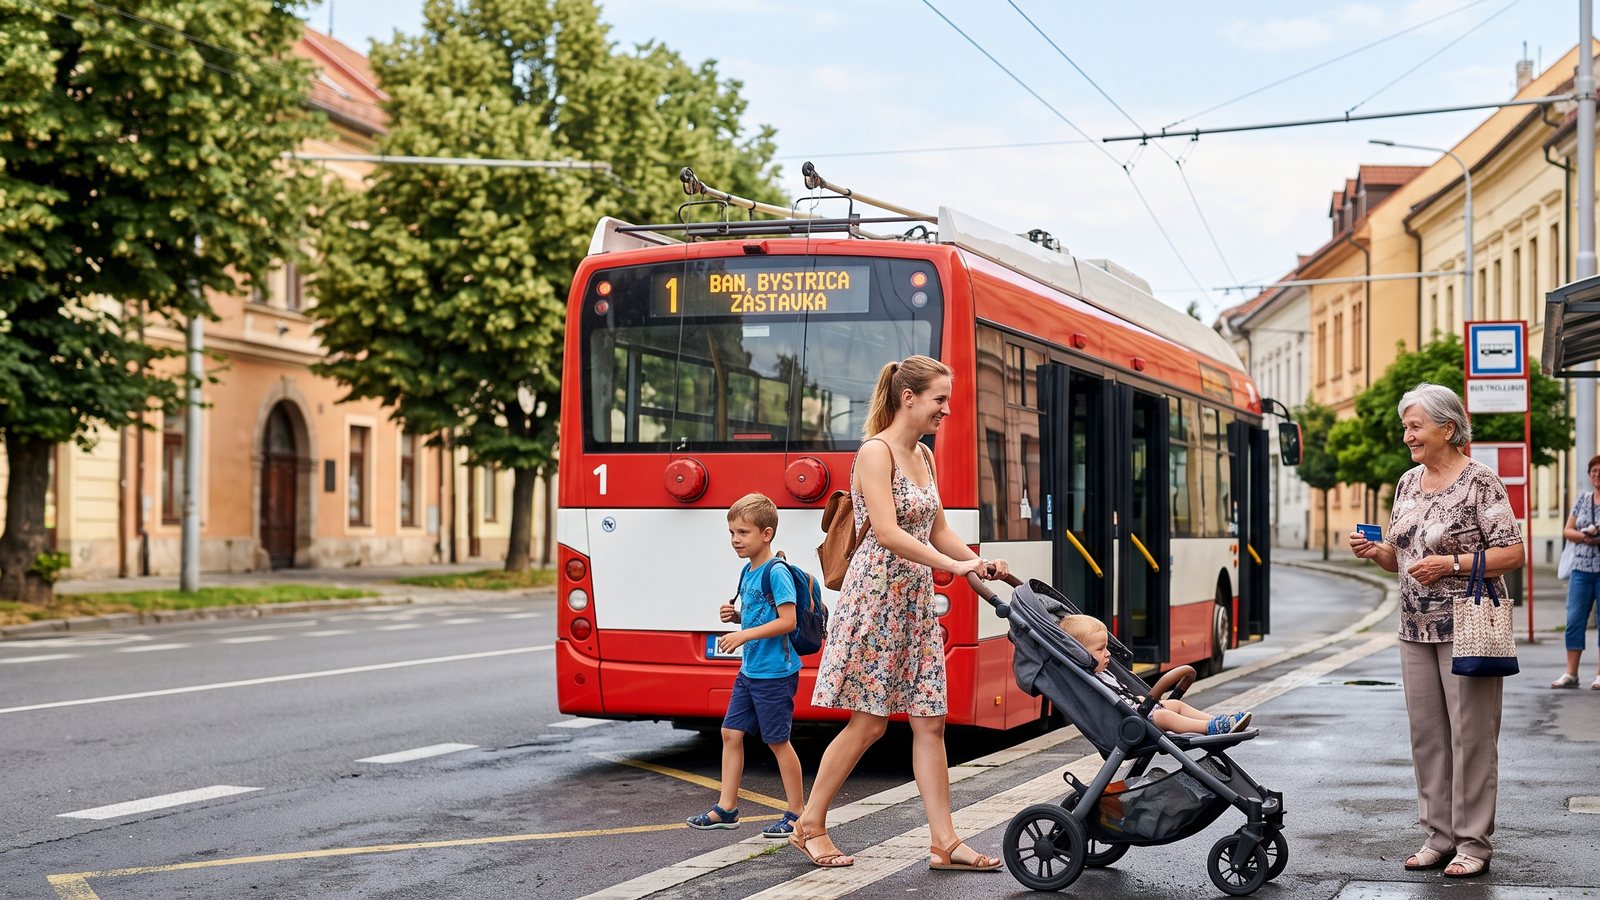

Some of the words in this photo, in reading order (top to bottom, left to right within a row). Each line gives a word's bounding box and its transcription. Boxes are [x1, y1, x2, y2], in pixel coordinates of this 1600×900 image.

[665, 277, 678, 314] 1
[757, 271, 850, 291] BYSTRICA
[593, 463, 607, 495] 1
